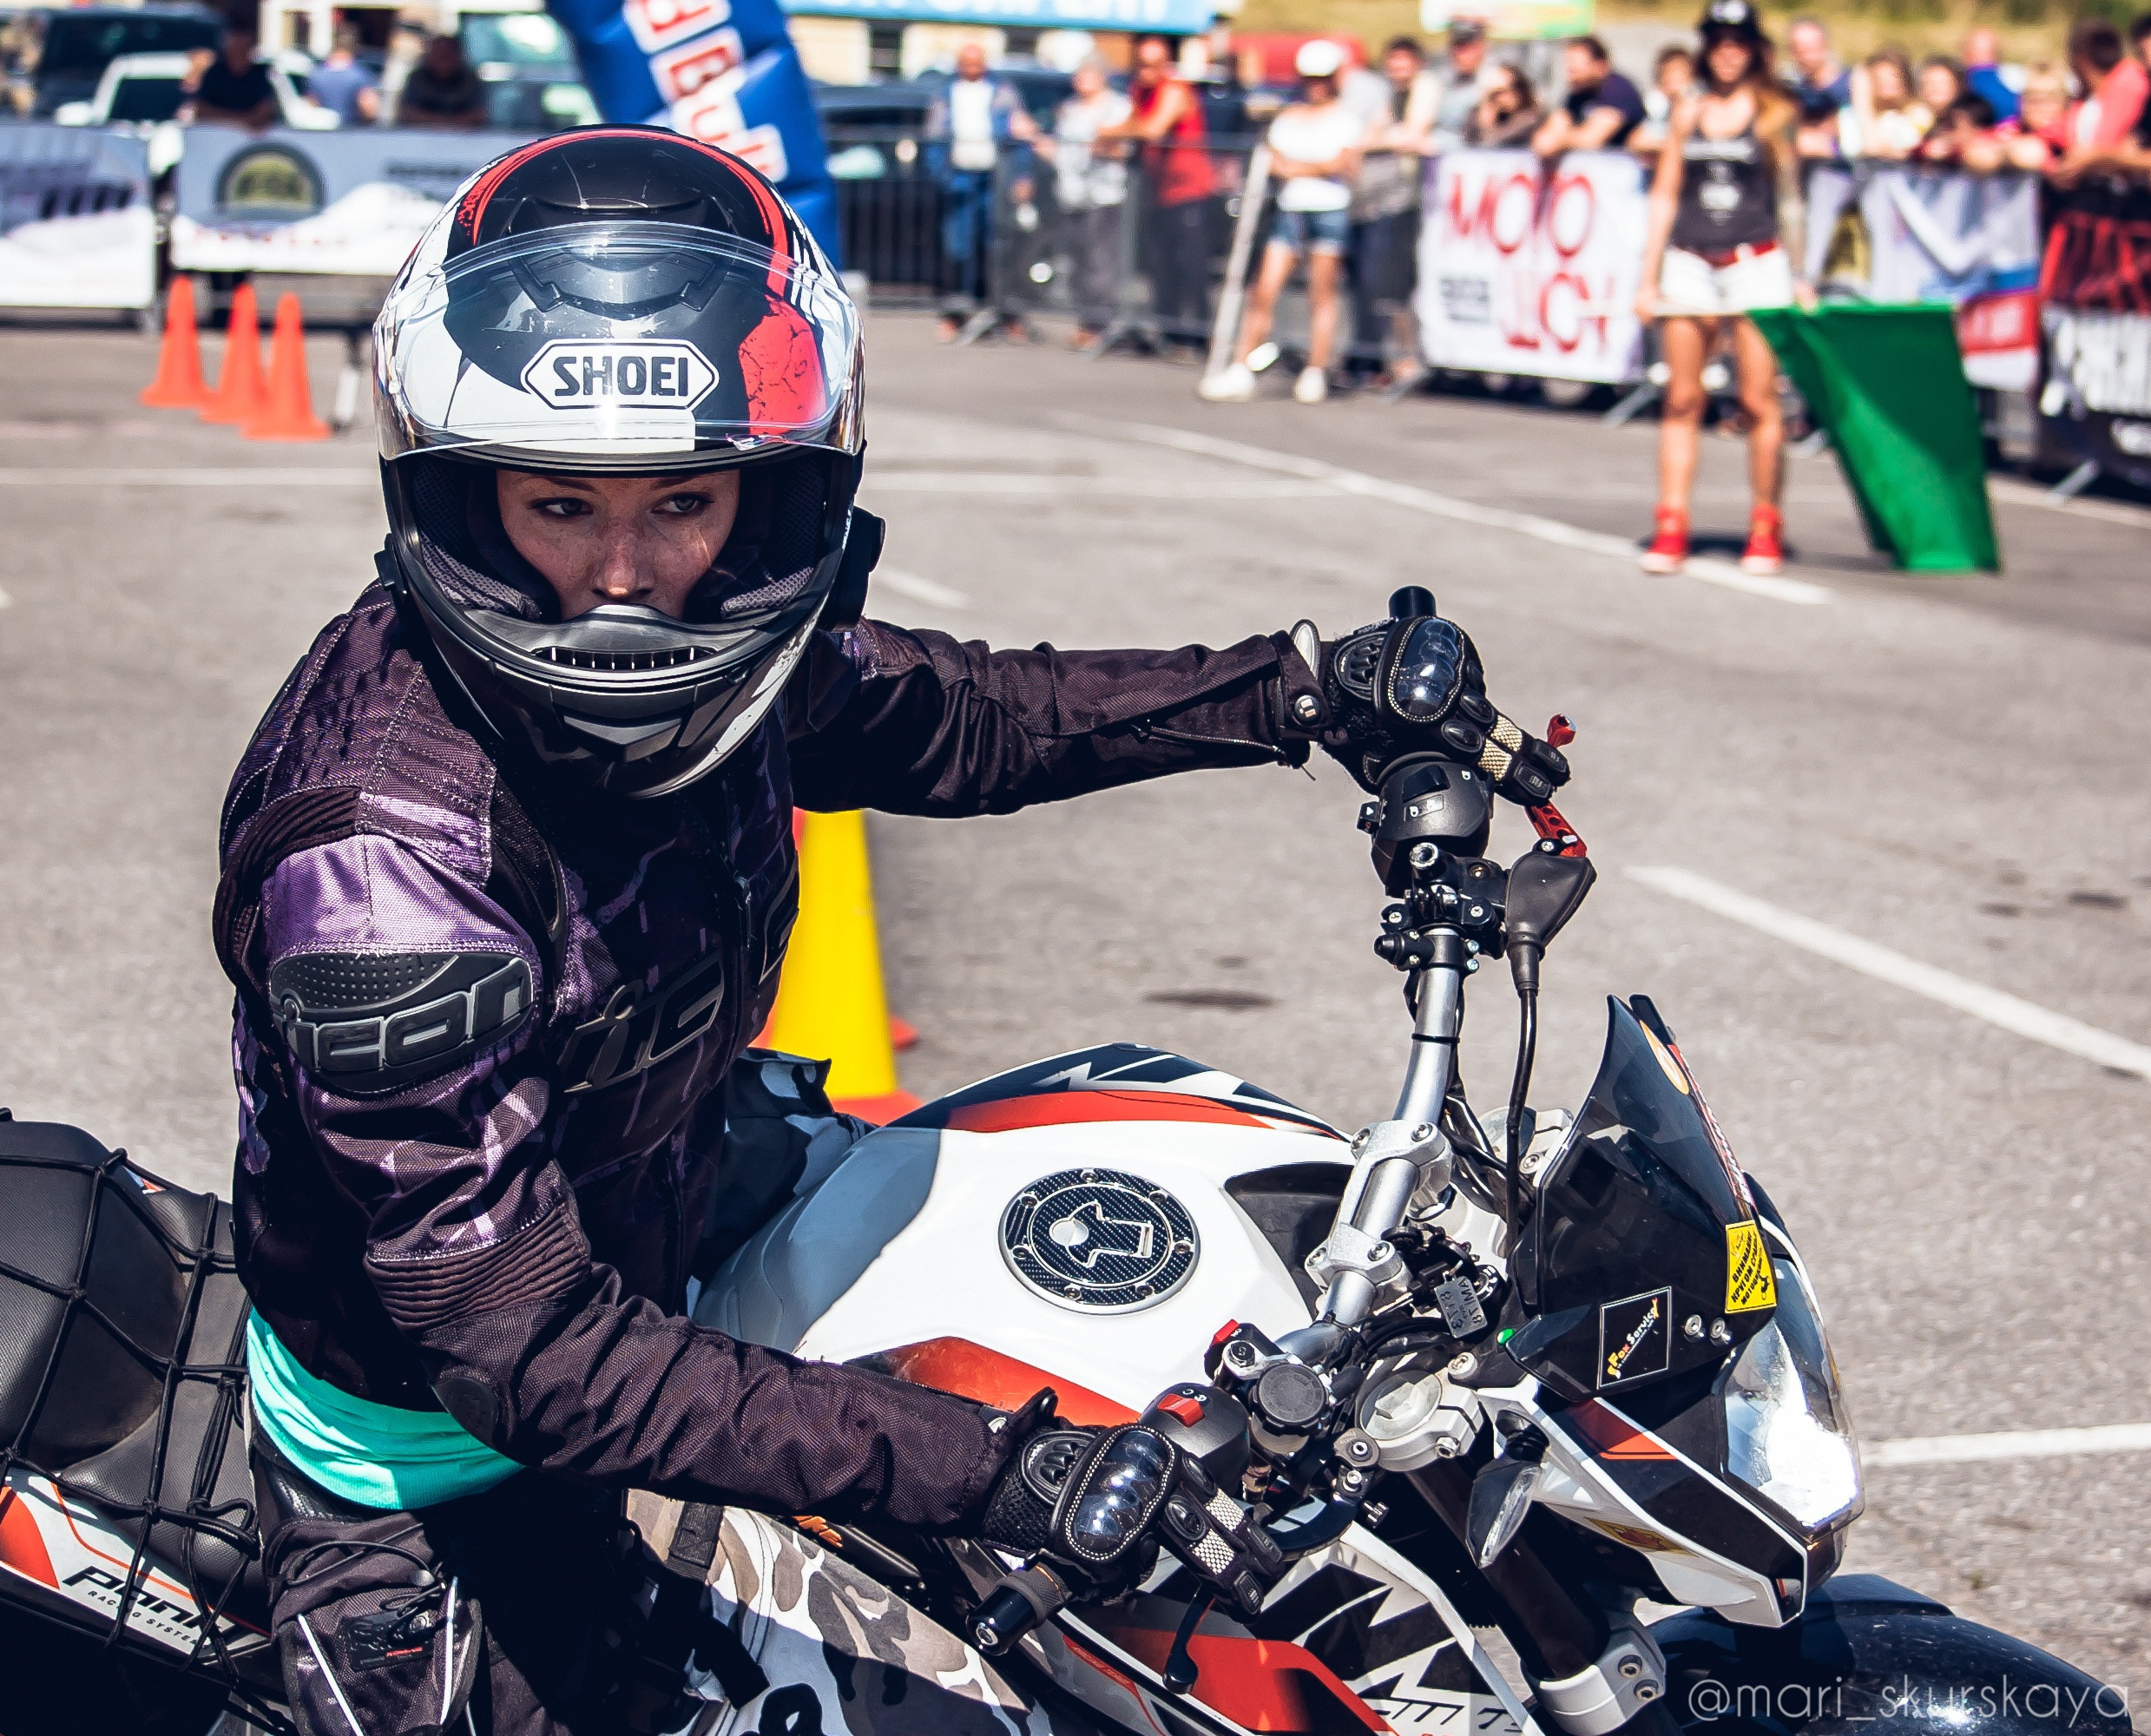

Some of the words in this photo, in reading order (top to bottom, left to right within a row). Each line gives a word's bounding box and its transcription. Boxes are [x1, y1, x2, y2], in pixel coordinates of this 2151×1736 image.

[552, 356, 689, 398] SHOEI
[1608, 1343, 1631, 1368] Fox
[88, 1589, 141, 1619] RACG
